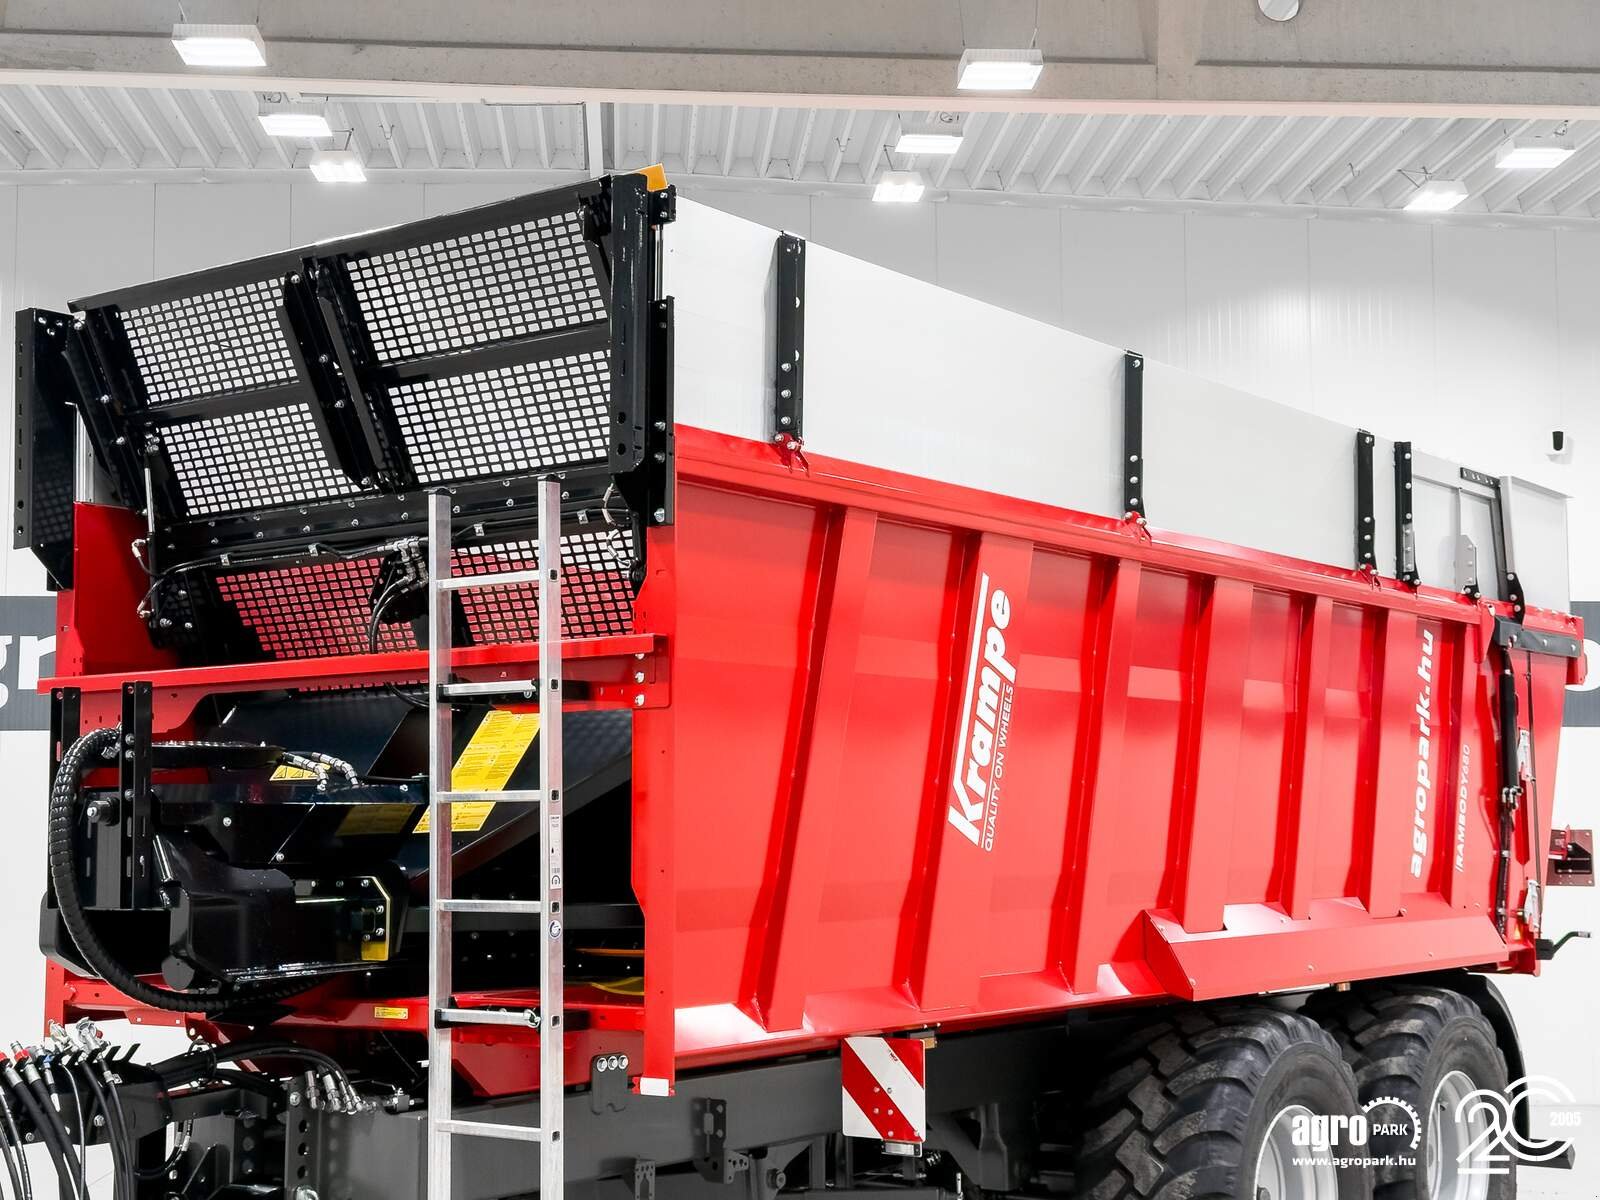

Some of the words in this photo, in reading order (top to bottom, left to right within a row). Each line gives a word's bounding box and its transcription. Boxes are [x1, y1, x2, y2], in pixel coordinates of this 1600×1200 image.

[948, 573, 1016, 846] Krampe
[997, 685, 1015, 748] WHEELS
[993, 751, 1004, 778] ON
[1410, 629, 1434, 878] agropark.hu
[983, 782, 1002, 852] QUALITY
